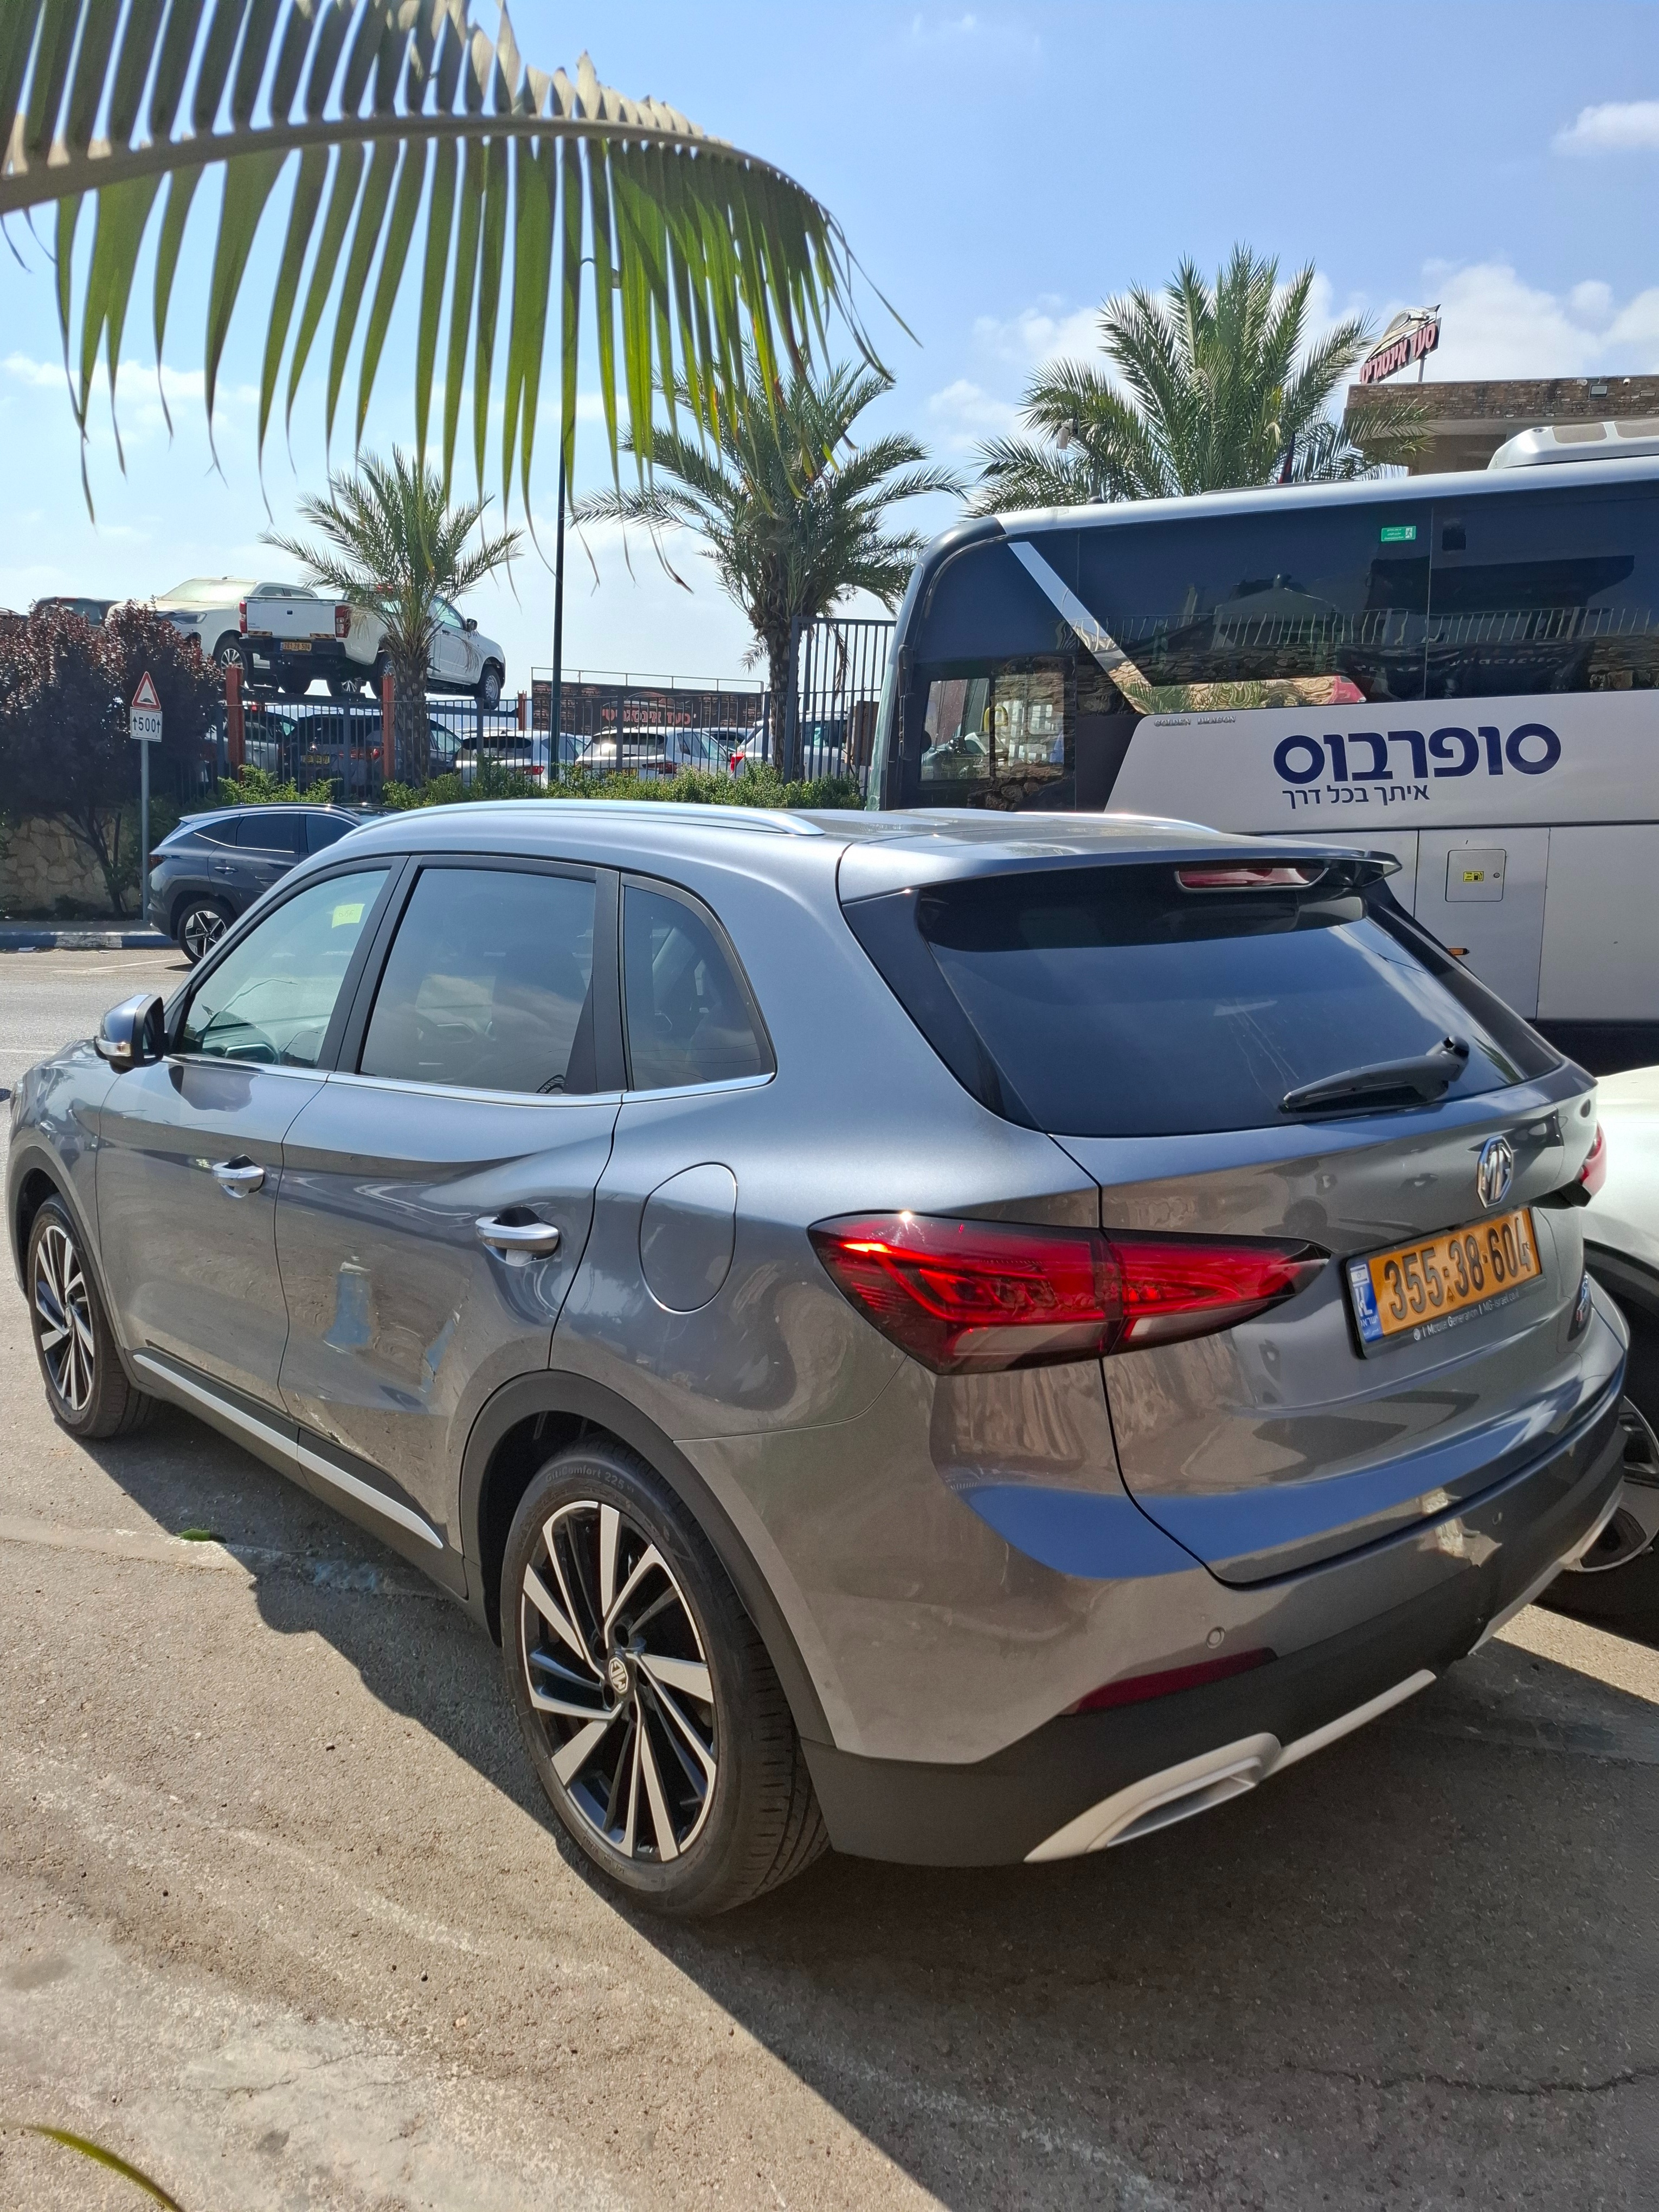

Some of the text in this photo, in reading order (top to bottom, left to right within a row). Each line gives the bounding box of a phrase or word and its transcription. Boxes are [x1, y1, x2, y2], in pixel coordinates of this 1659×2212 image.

[138, 717, 156, 732] 500
[1154, 716, 1236, 727] GOLDEN DRAGON
[1273, 723, 1561, 785] סופרבוס
[1282, 785, 1430, 809] איתך בכל דרך
[1479, 1139, 1512, 1204] MG
[1355, 1287, 1373, 1317] IL
[605, 1471, 625, 1490] 225
